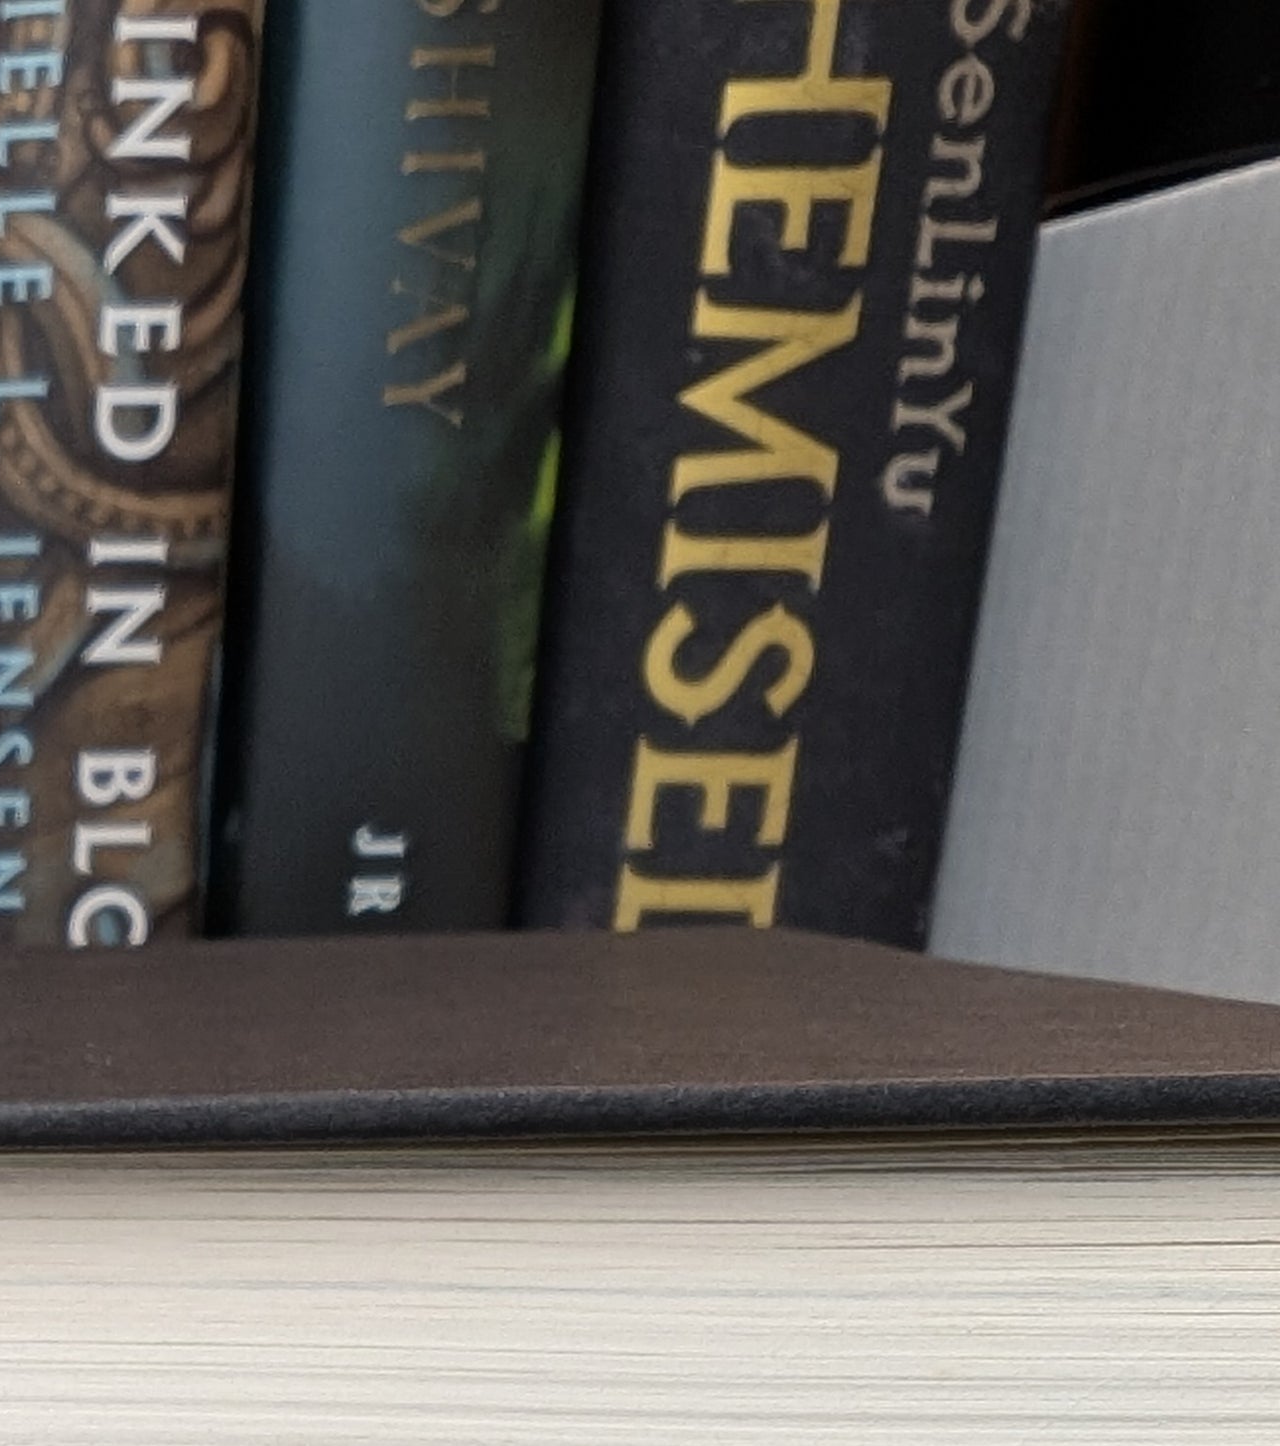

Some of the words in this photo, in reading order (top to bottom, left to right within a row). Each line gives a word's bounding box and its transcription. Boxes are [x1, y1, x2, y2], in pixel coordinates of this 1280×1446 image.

[95, 15, 197, 462] INKED
[383, 0, 498, 428] HIVAY
[82, 536, 169, 666] IN
